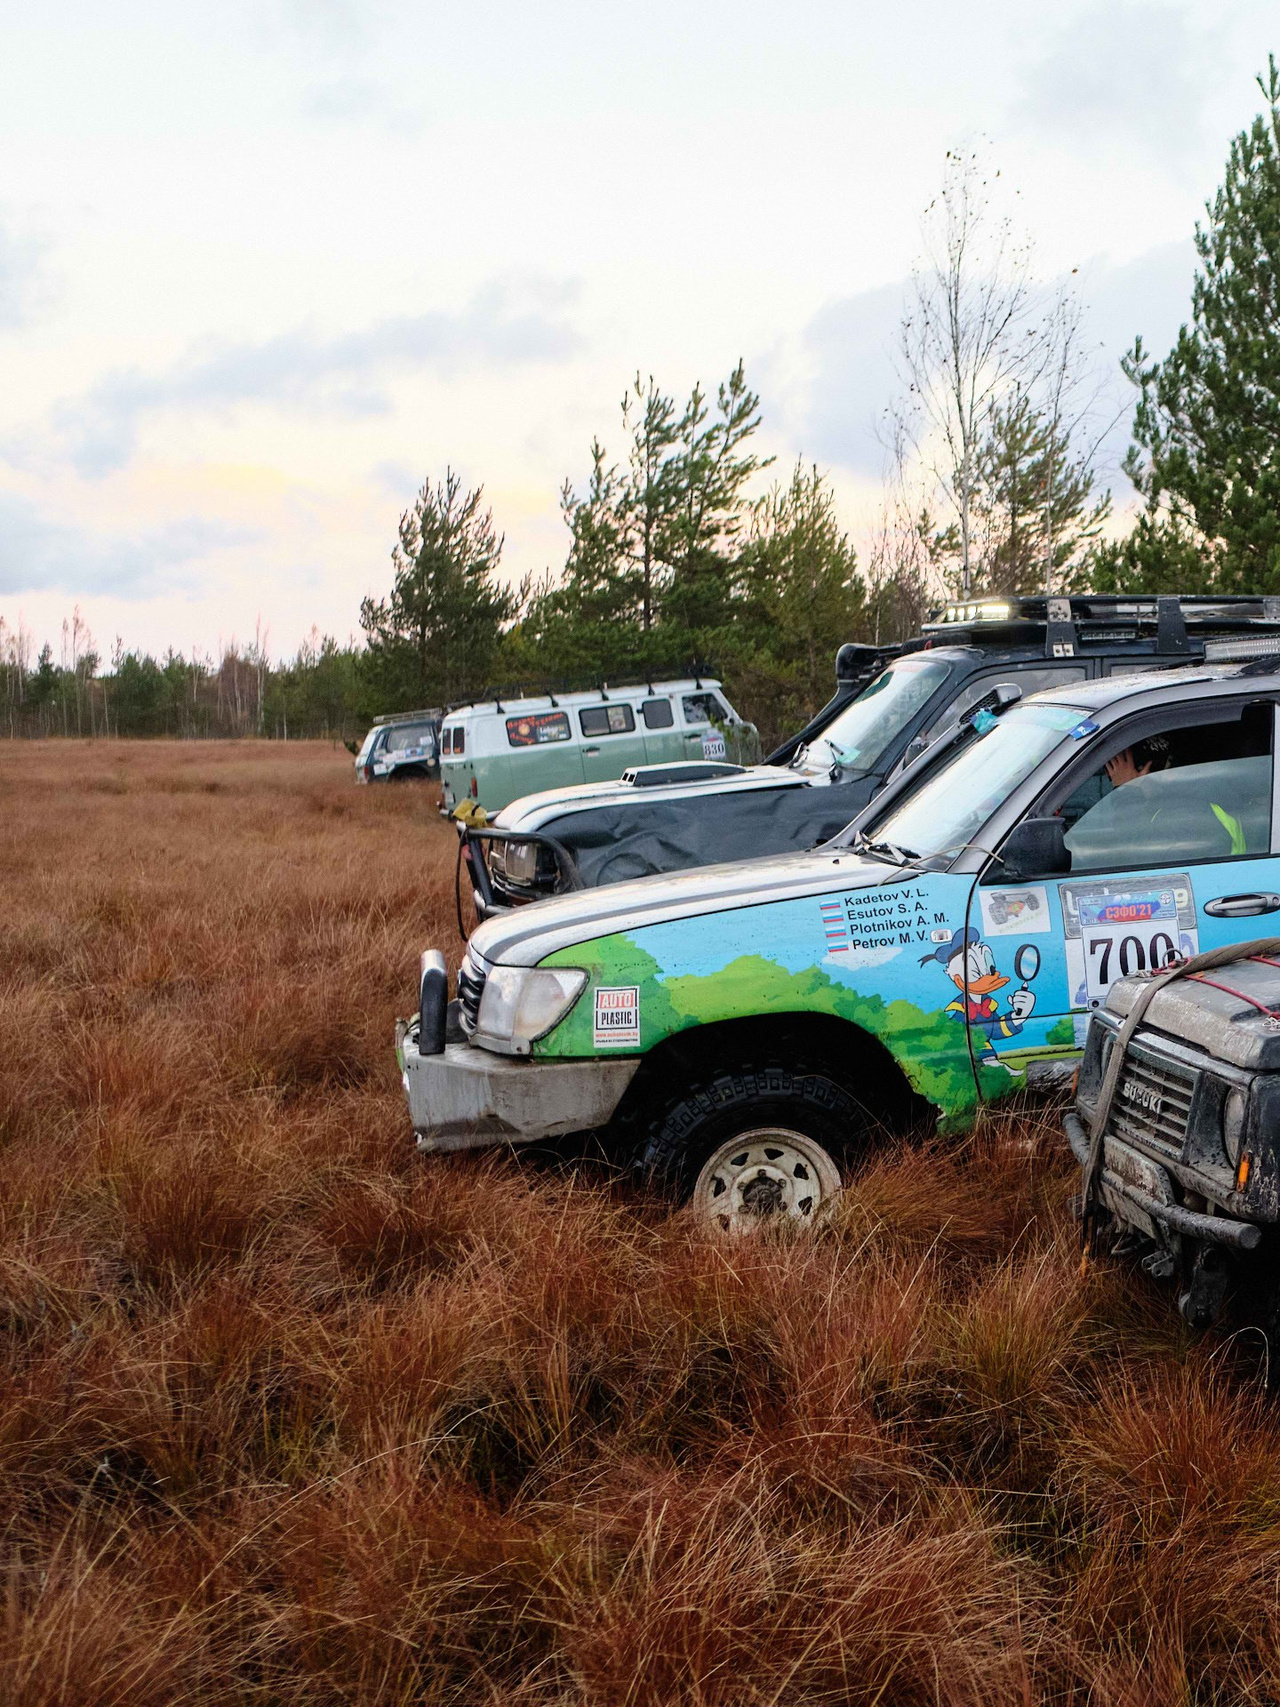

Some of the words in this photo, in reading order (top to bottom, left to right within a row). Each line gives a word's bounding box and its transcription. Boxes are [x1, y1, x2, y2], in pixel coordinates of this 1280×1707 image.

[845, 891, 899, 906] Kadetov
[902, 889, 914, 899] V.
[917, 888, 929, 897] L.
[847, 906, 894, 920] Esutov
[897, 903, 911, 914] S.
[914, 901, 928, 912] A.
[850, 918, 912, 935] Plotnikov
[917, 915, 930, 926] A.
[934, 912, 950, 923] M.
[853, 936, 895, 950] Petrov
[900, 932, 914, 944] M.
[917, 930, 928, 941] V.
[1090, 932, 1176, 985] 700
[600, 992, 634, 1008] AUTO
[601, 1011, 632, 1025] PLASTIC
